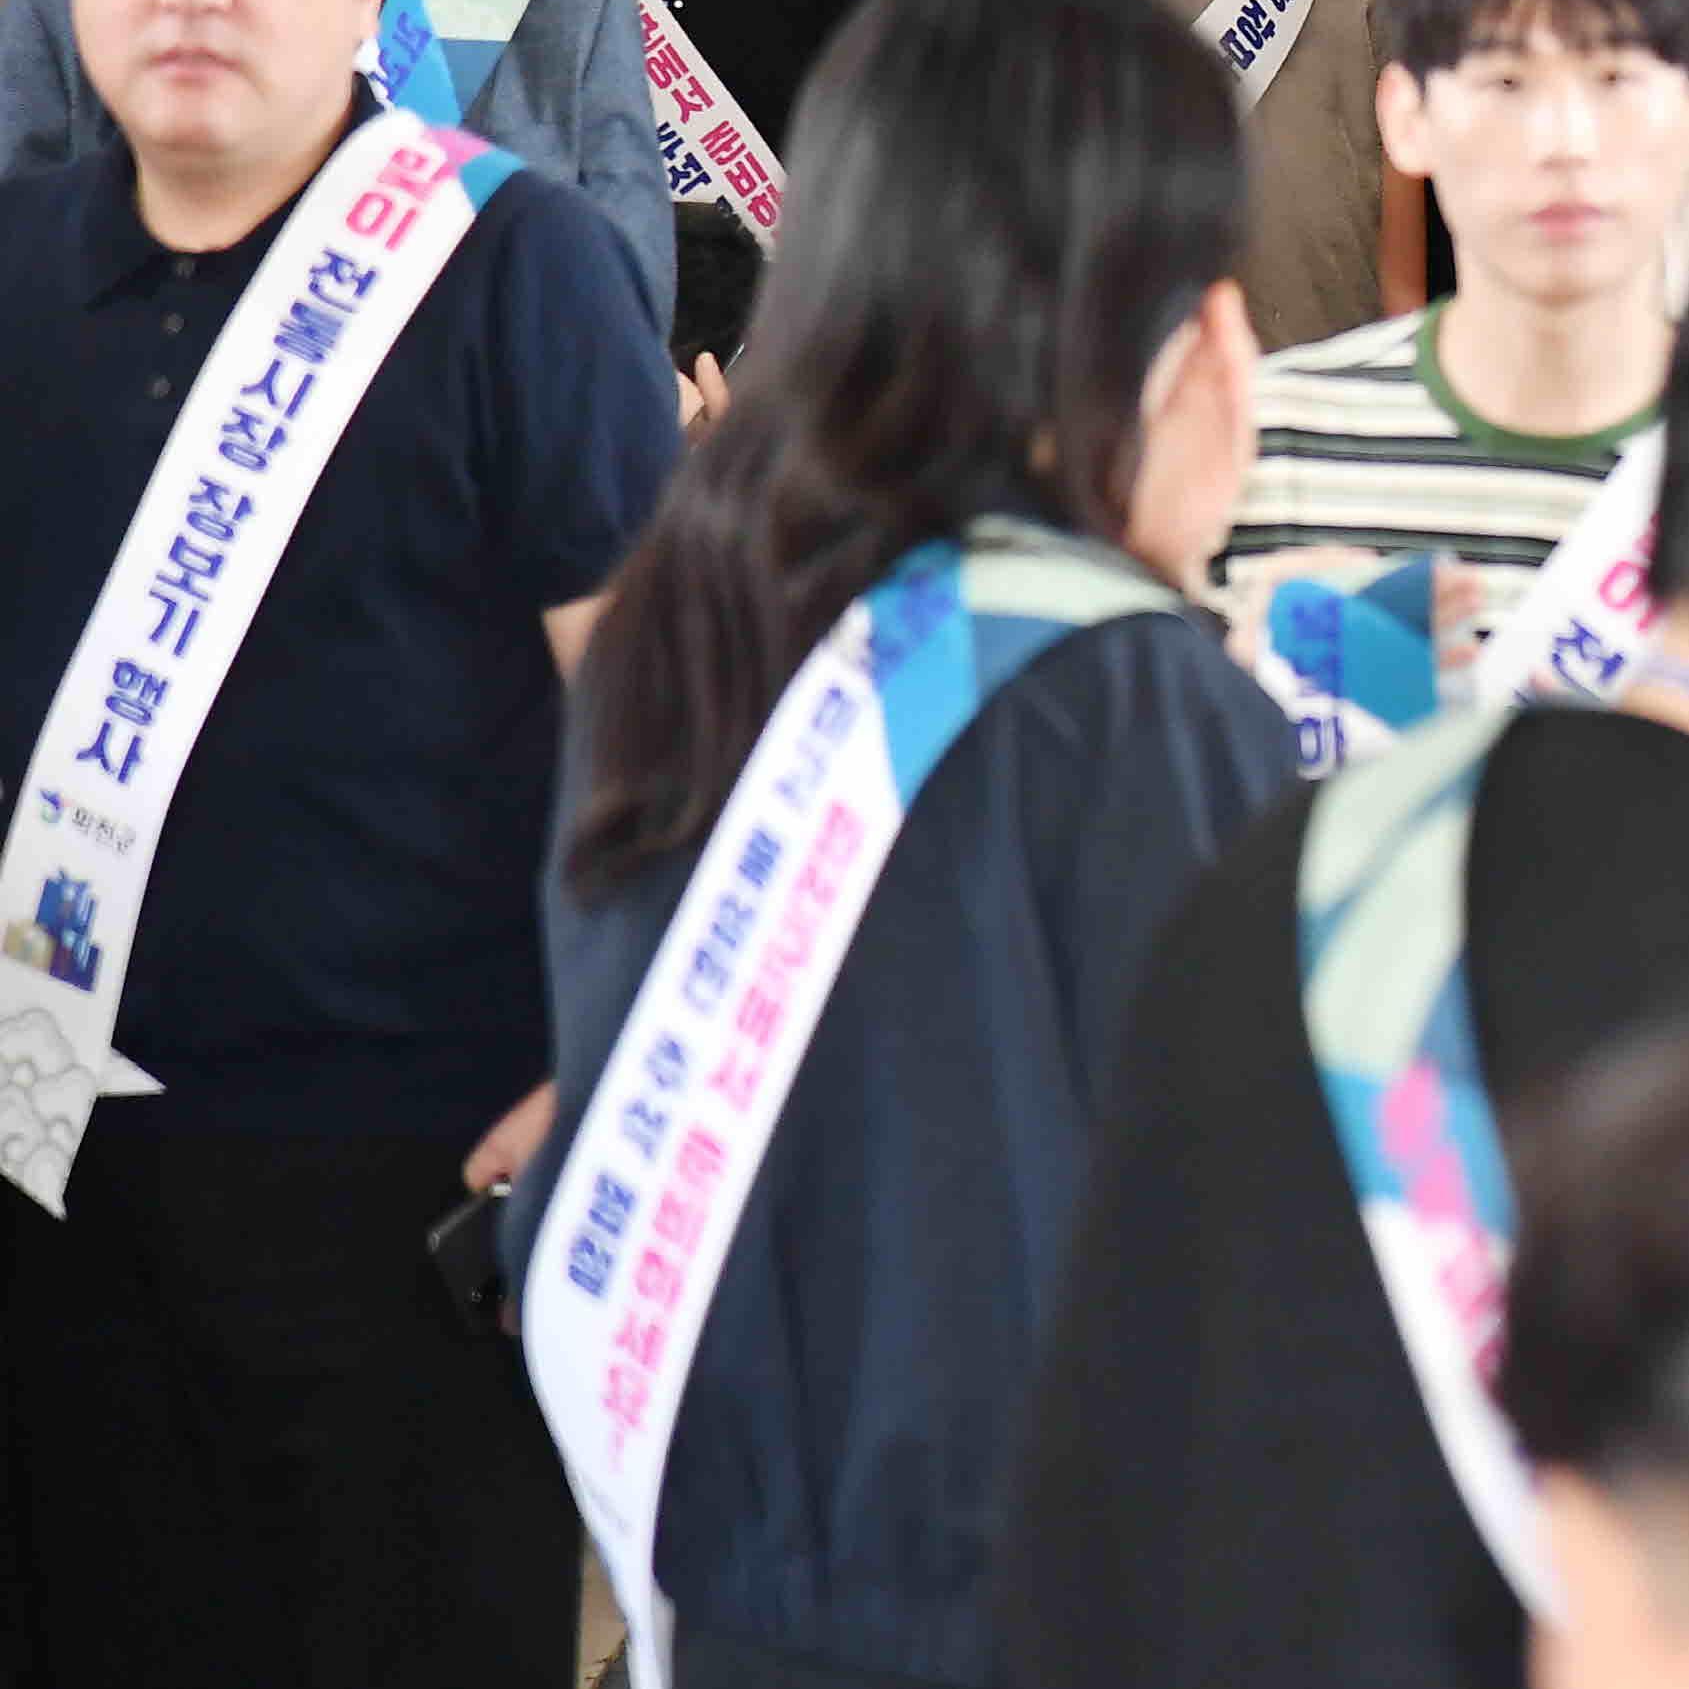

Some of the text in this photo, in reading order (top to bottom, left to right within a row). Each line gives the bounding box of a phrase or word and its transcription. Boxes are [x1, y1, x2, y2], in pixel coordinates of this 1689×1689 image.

[76, 131, 458, 789] 맞이 전통시장 장보기 행사
